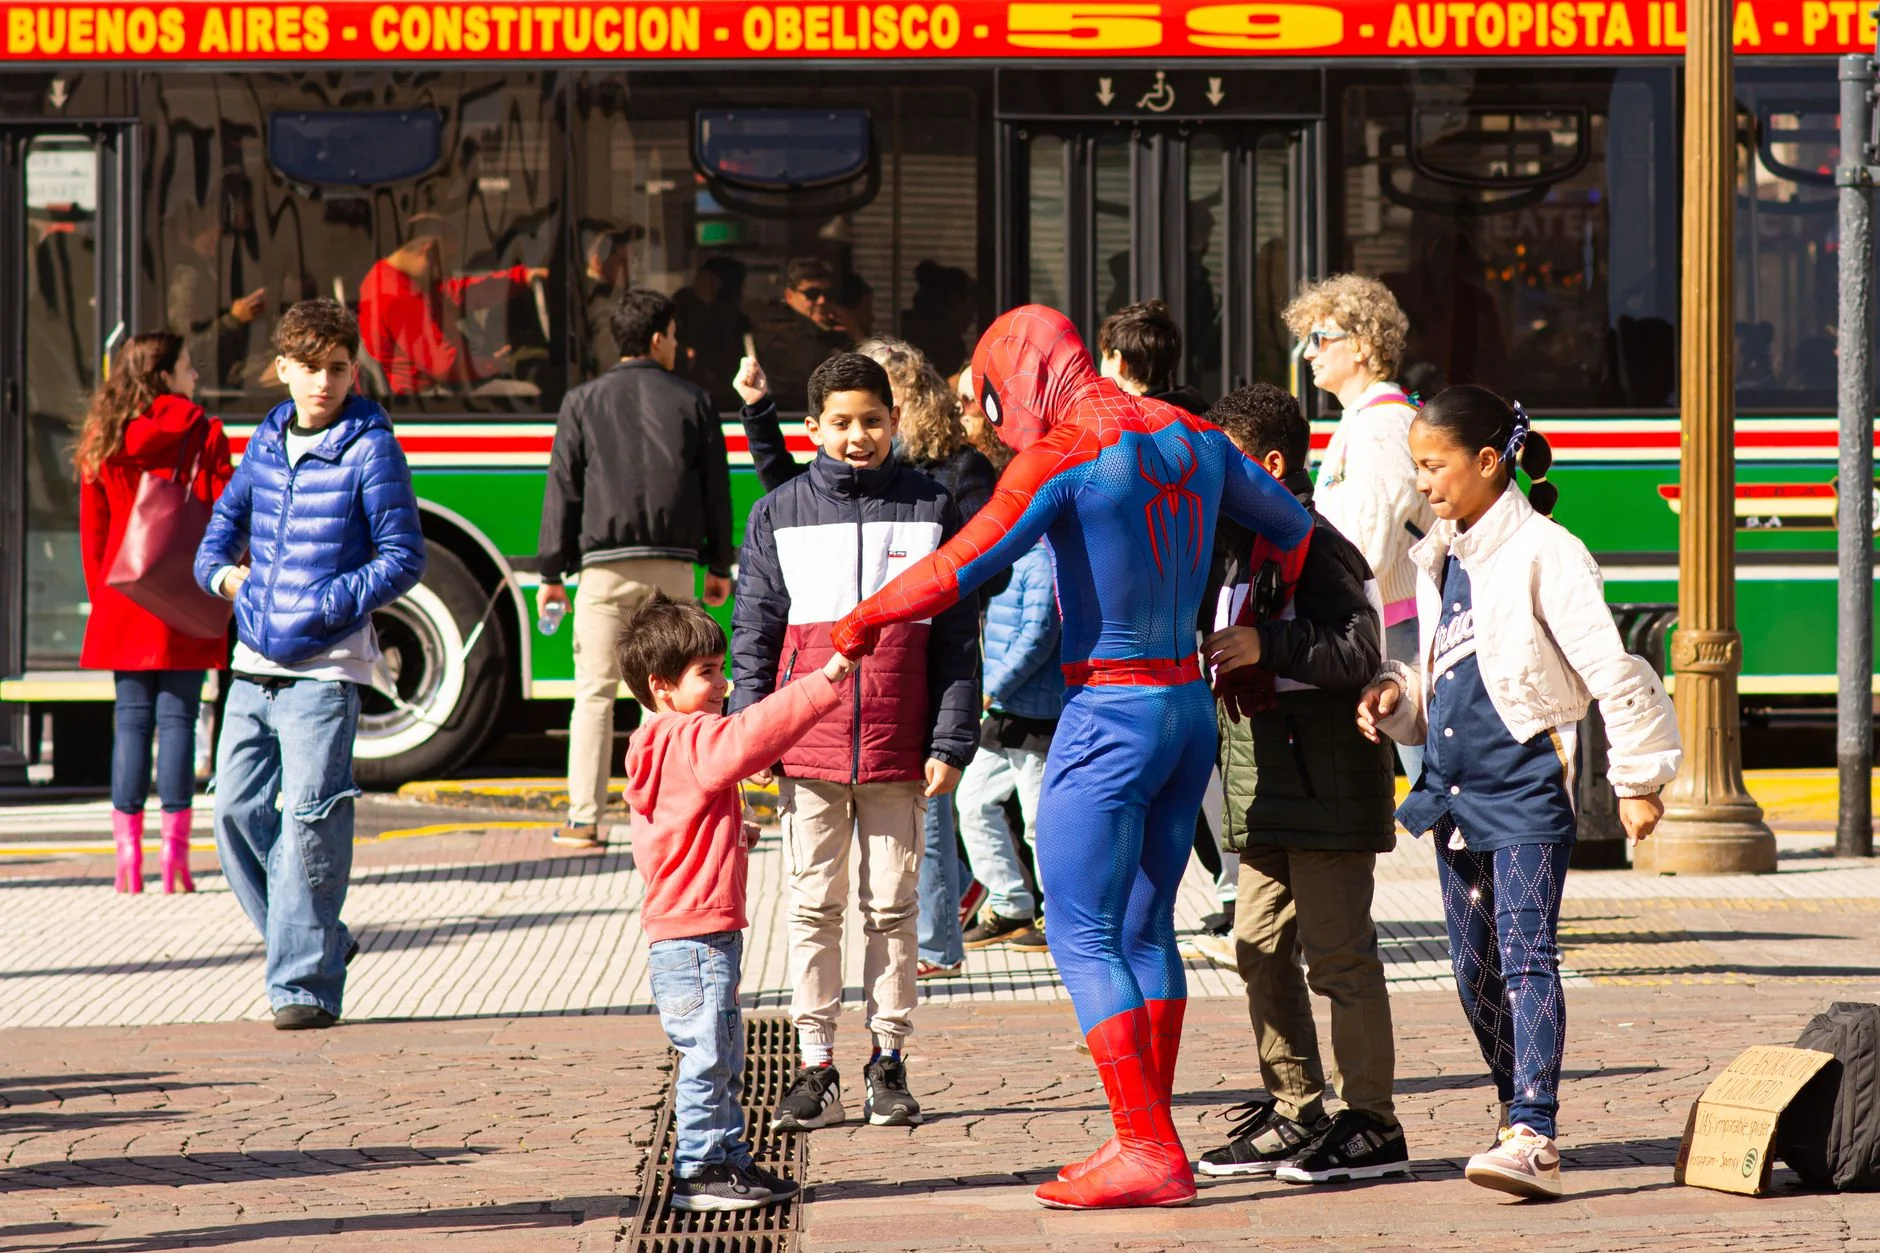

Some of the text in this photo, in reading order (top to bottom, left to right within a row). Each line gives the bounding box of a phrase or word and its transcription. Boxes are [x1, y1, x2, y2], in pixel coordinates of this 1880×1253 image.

[8, 7, 185, 53] BUENOS
[199, 6, 330, 52] AIRES
[371, 5, 700, 52] CONSTITUCION
[743, 4, 960, 51] OBELISCO
[1007, 3, 1343, 50] 59
[1387, 2, 1634, 48] AUTOPISTA
[1648, 2, 1761, 47] ILA
